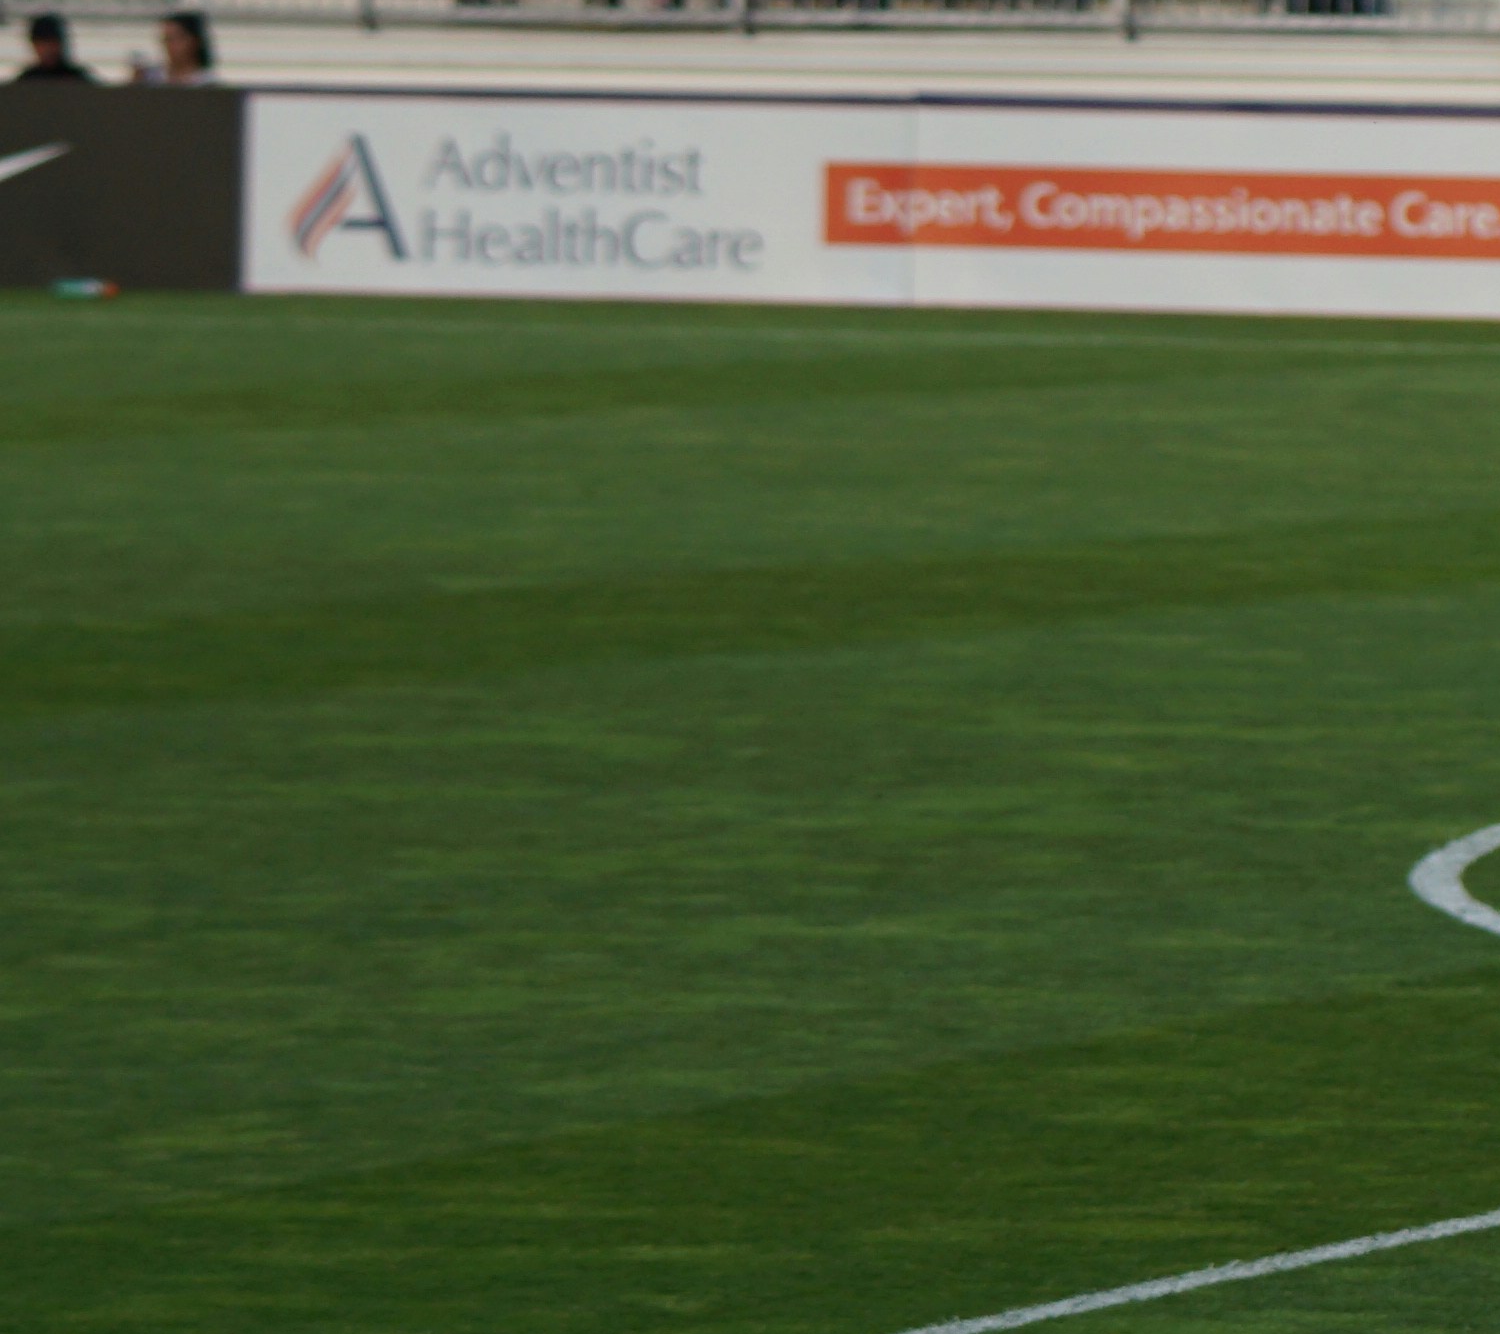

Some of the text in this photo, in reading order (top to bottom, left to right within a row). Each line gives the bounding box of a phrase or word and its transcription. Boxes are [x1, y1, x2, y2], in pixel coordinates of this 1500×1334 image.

[425, 132, 703, 196] Adventist
[417, 207, 766, 272] HealthCare
[844, 175, 1014, 234] Expert,
[1018, 180, 1385, 242] Compassionate
